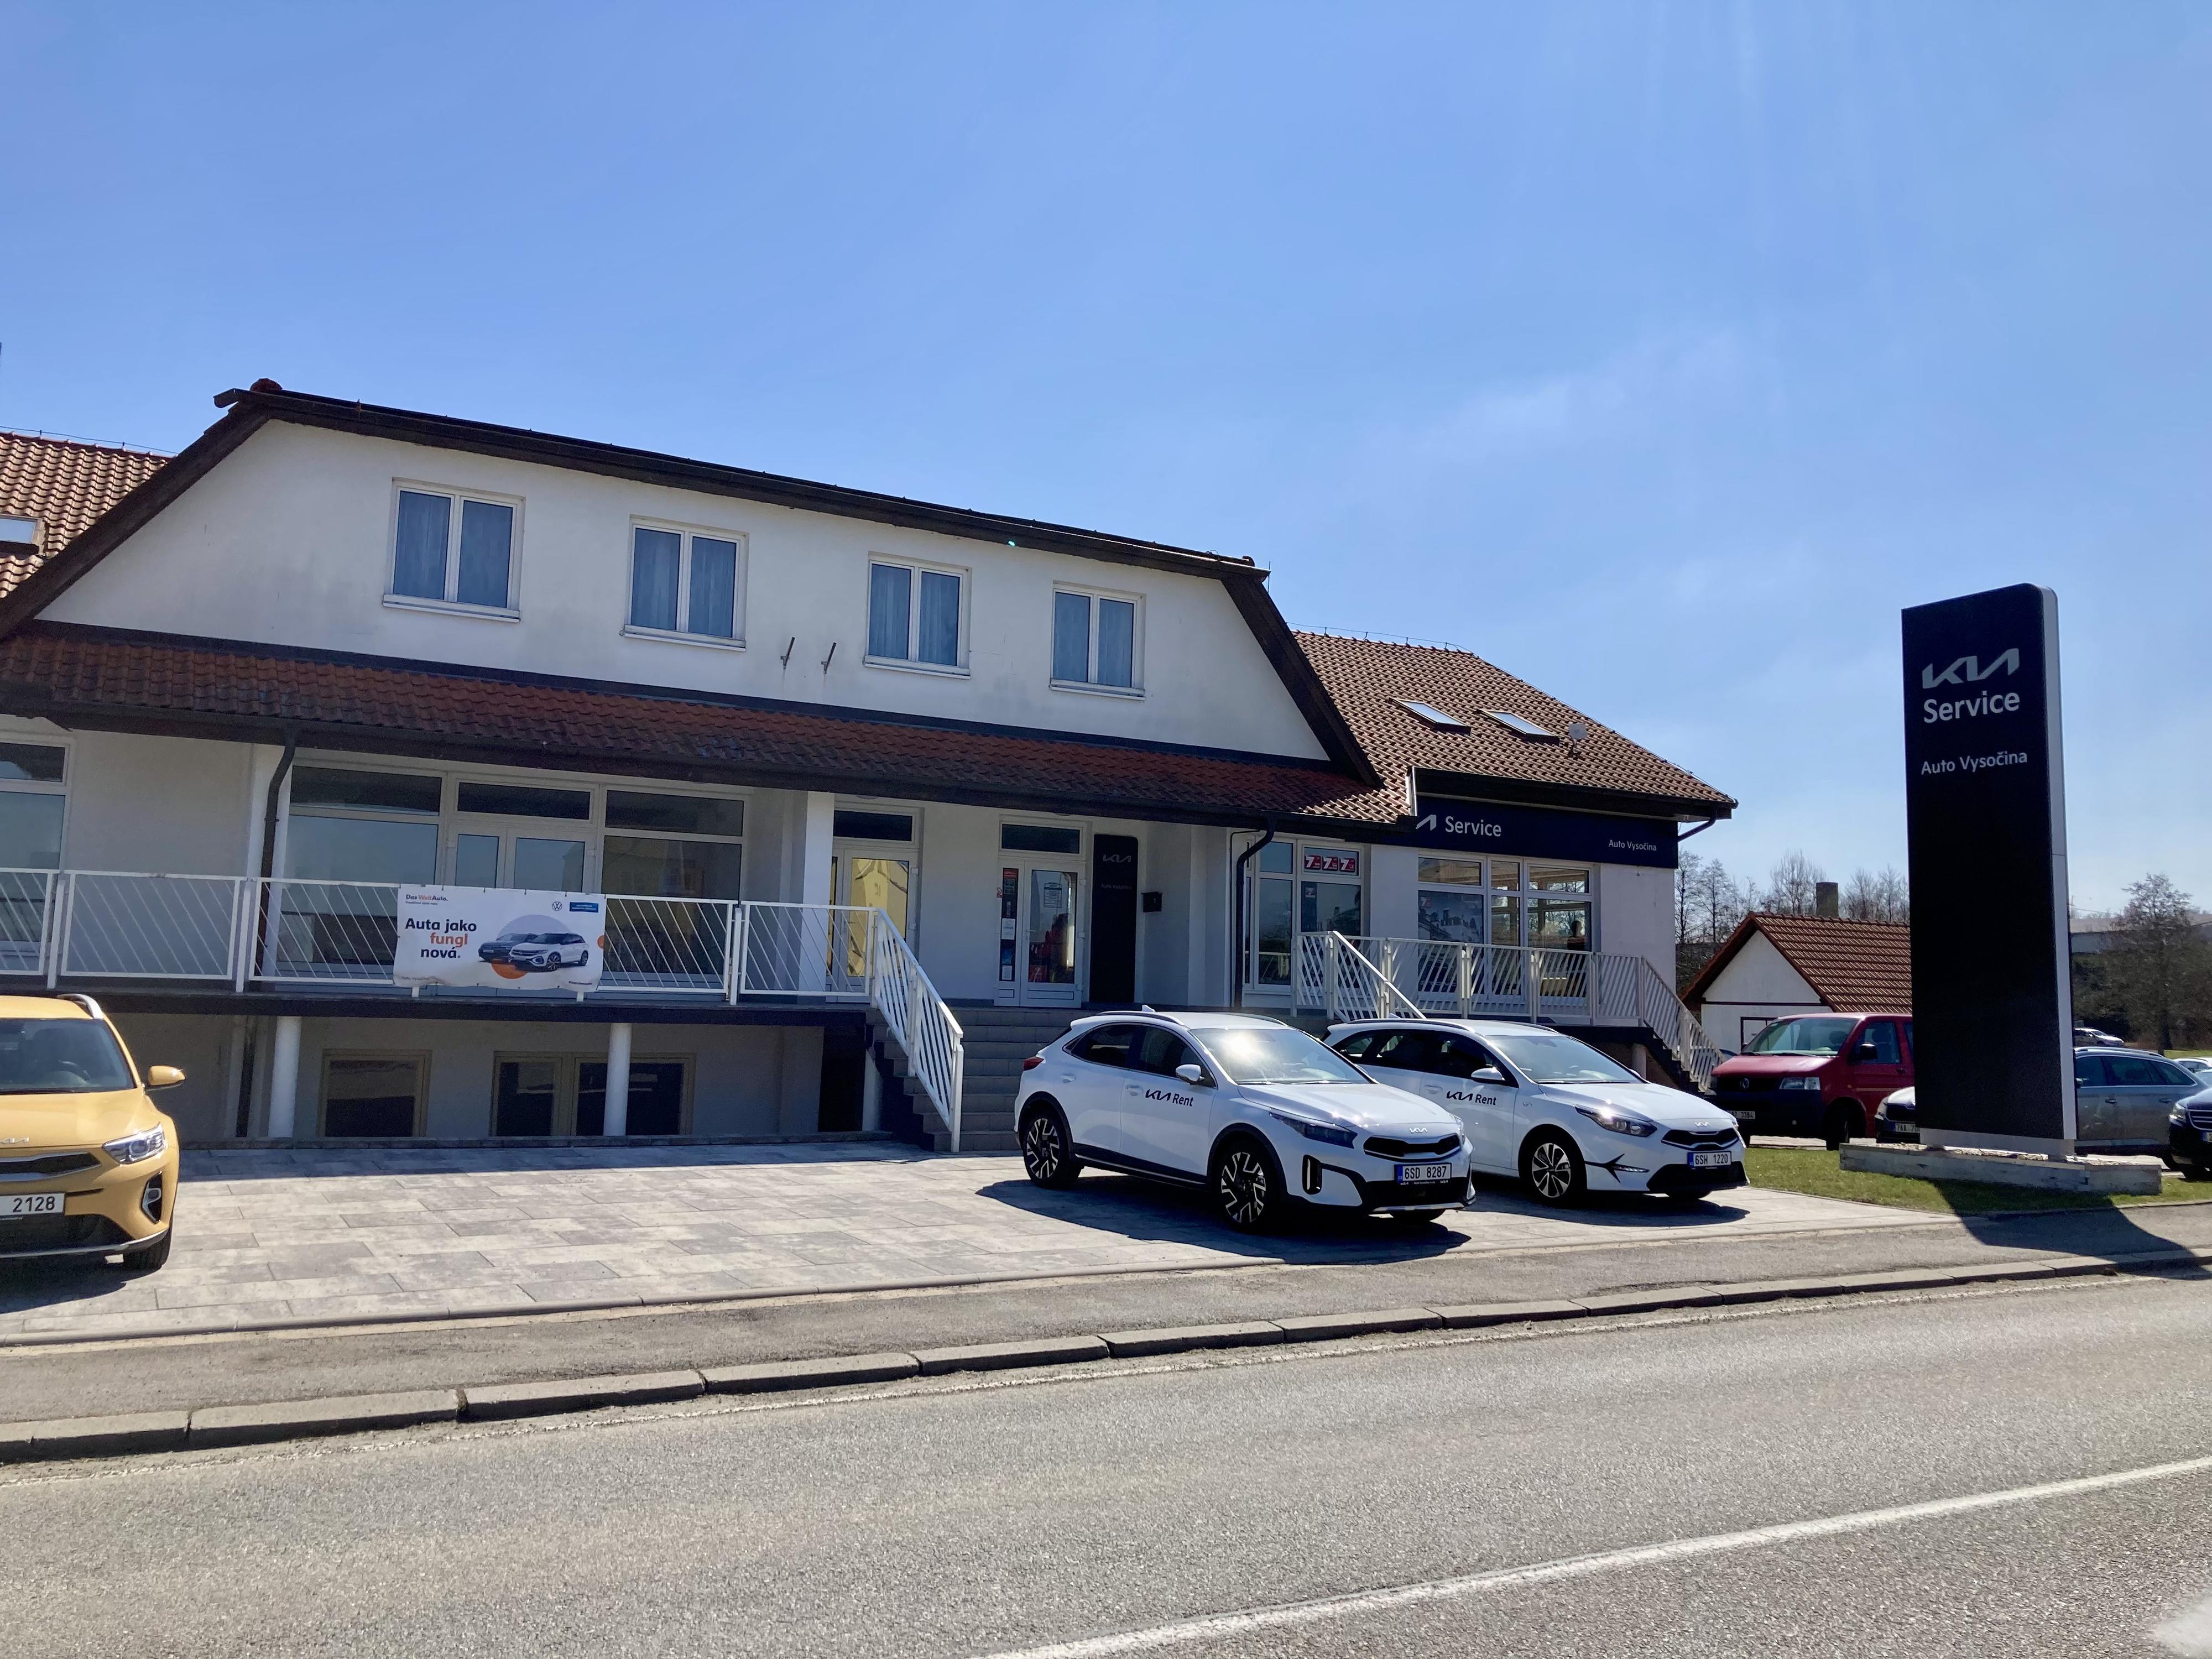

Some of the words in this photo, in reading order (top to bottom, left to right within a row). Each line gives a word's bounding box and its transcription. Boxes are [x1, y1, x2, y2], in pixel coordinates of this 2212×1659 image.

[1922, 648, 2020, 689] KIA
[1923, 691, 2020, 723] Service
[1921, 761, 1955, 775] Auto
[1960, 751, 2028, 772] Vysočina
[1445, 816, 1502, 837] Service
[1608, 839, 1625, 848] Auto
[1626, 841, 1657, 851] Vysočina
[405, 918, 440, 930] Auta
[444, 919, 477, 933] jako
[430, 932, 468, 947] fungl
[420, 946, 461, 958] nová.
[1145, 1089, 1172, 1102] KIA
[1172, 1093, 1194, 1107] Rent
[1446, 1091, 1473, 1102] KIA
[1475, 1094, 1496, 1105] Rent
[1695, 1154, 1708, 1165] 6SH
[1713, 1154, 1728, 1164] 1220
[1405, 1167, 1420, 1179] 6SD
[1427, 1166, 1447, 1178] 8287
[13, 1196, 55, 1213] 2128
